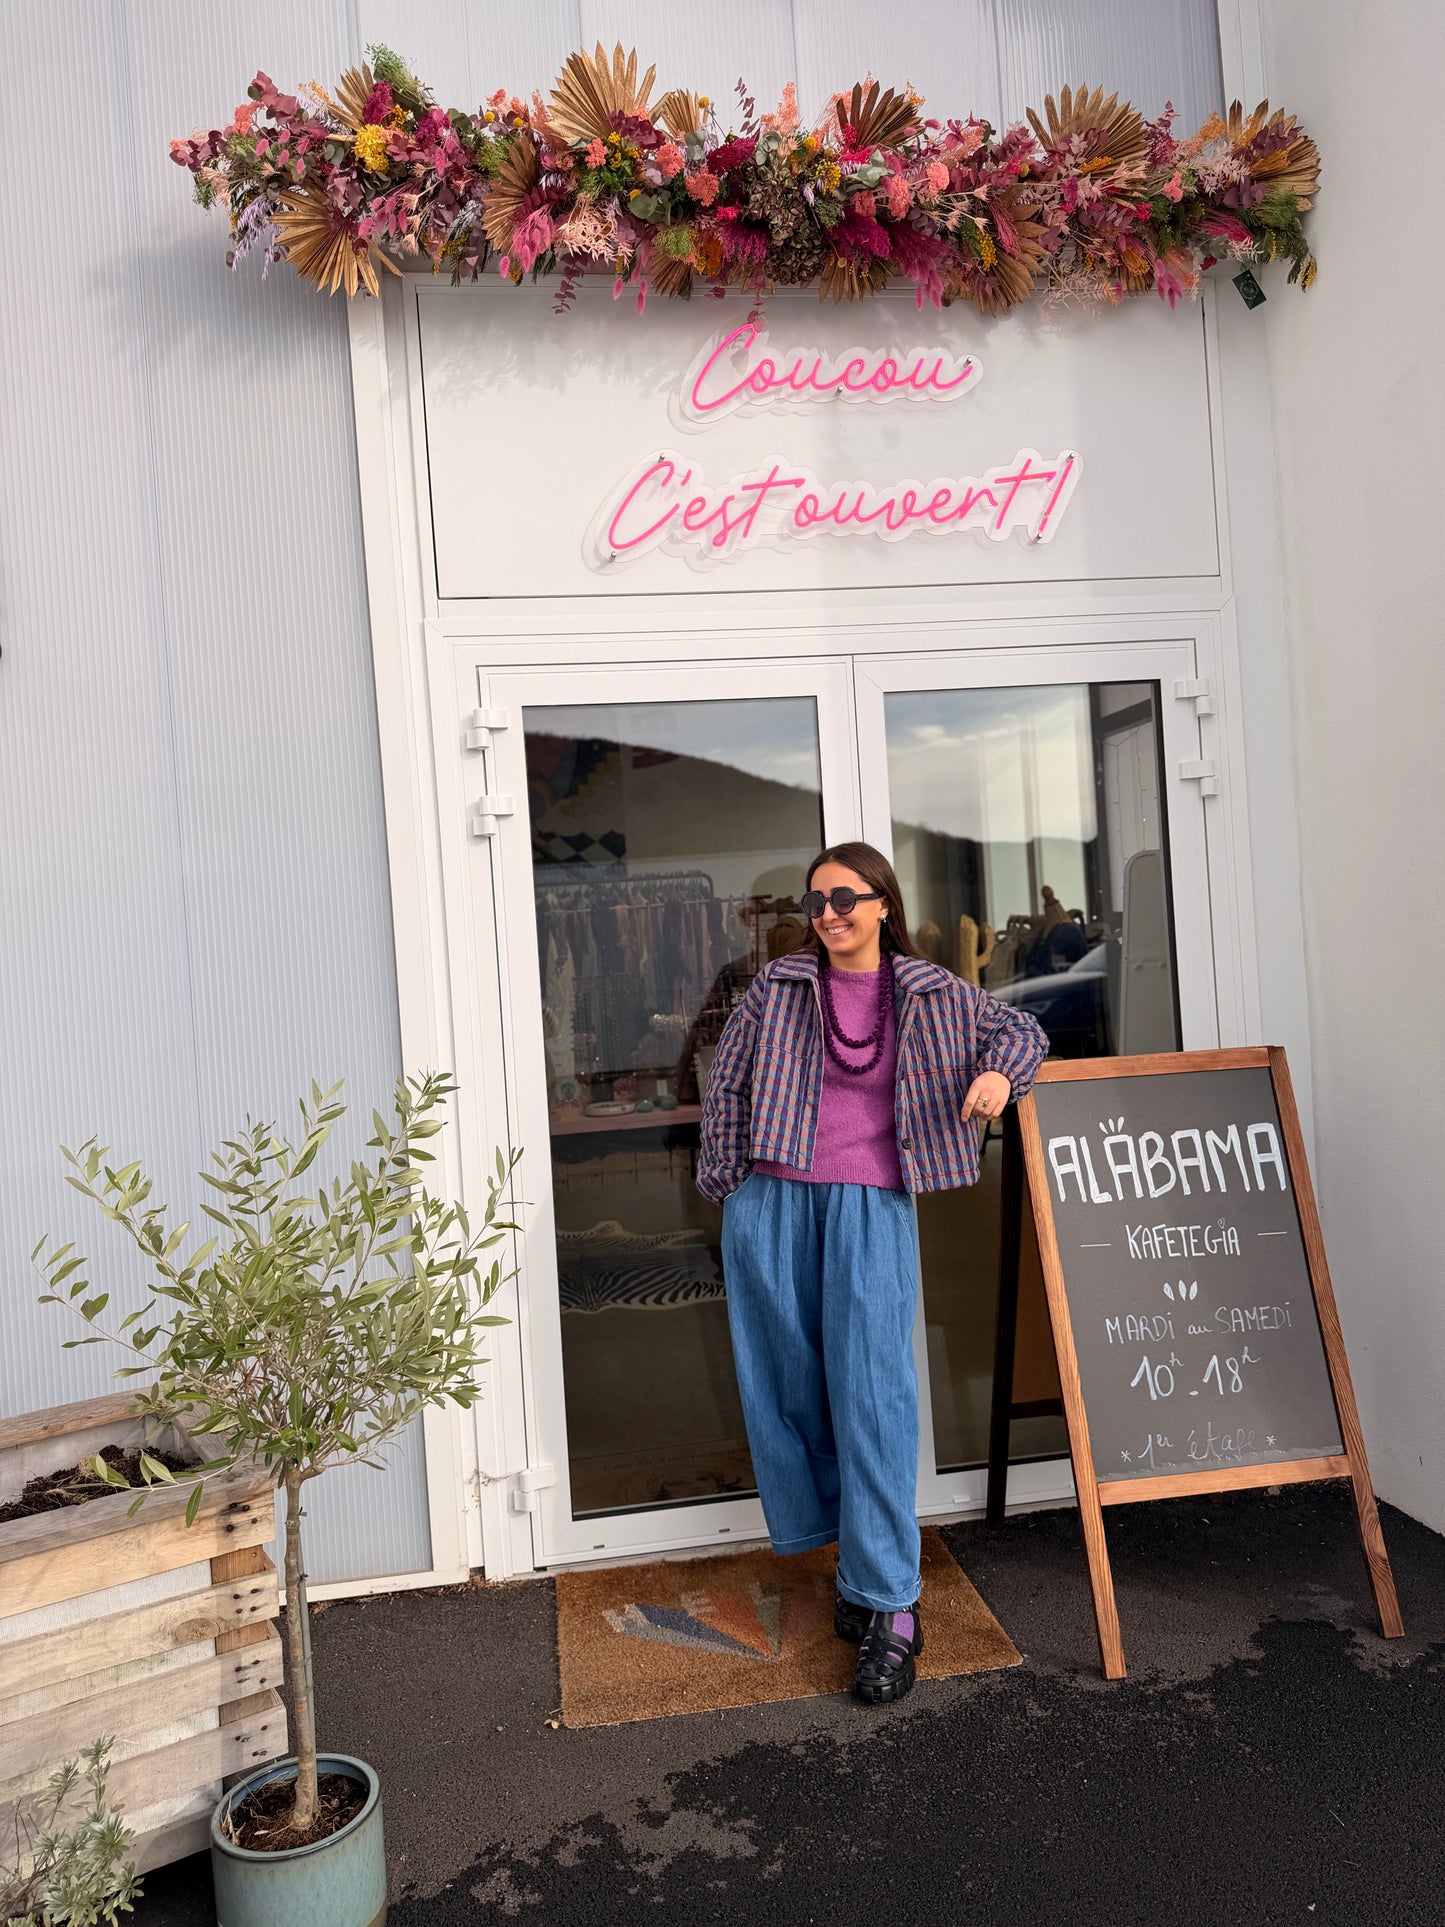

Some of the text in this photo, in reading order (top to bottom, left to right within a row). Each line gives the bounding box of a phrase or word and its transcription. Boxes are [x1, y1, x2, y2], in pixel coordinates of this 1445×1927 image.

[691, 323, 974, 411] Coucou
[608, 460, 806, 551] C'est
[1048, 1121, 1287, 1204] ALABAMA
[1187, 1322, 1213, 1336] au
